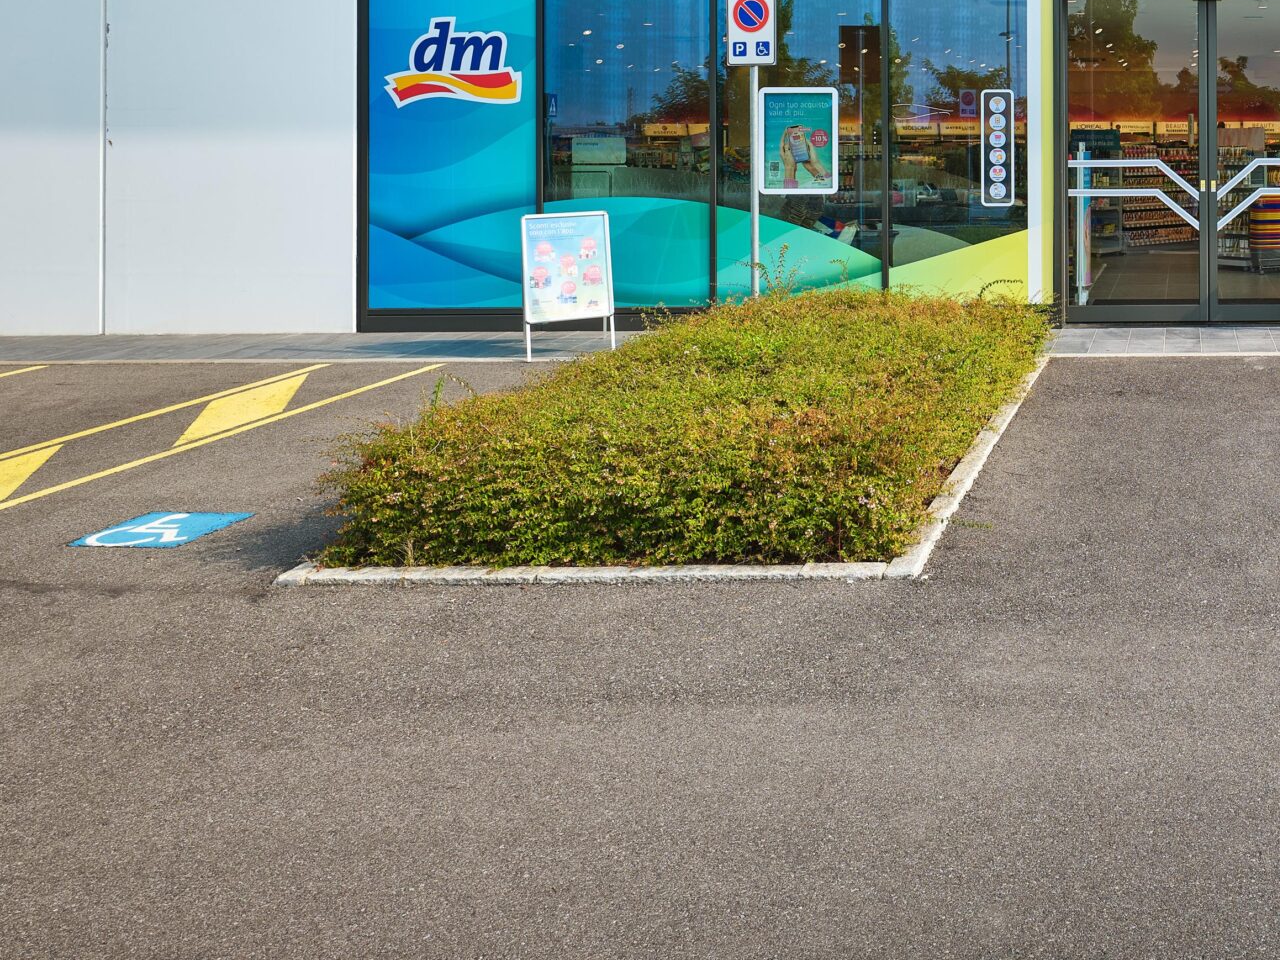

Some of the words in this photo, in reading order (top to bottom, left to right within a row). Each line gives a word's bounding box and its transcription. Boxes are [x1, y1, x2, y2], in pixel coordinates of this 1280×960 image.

[413, 21, 503, 73] dm
[735, 43, 745, 55] P
[768, 101, 785, 111] Ogni
[800, 101, 828, 111] acquisto
[769, 109, 783, 117] vale
[784, 109, 792, 117] di
